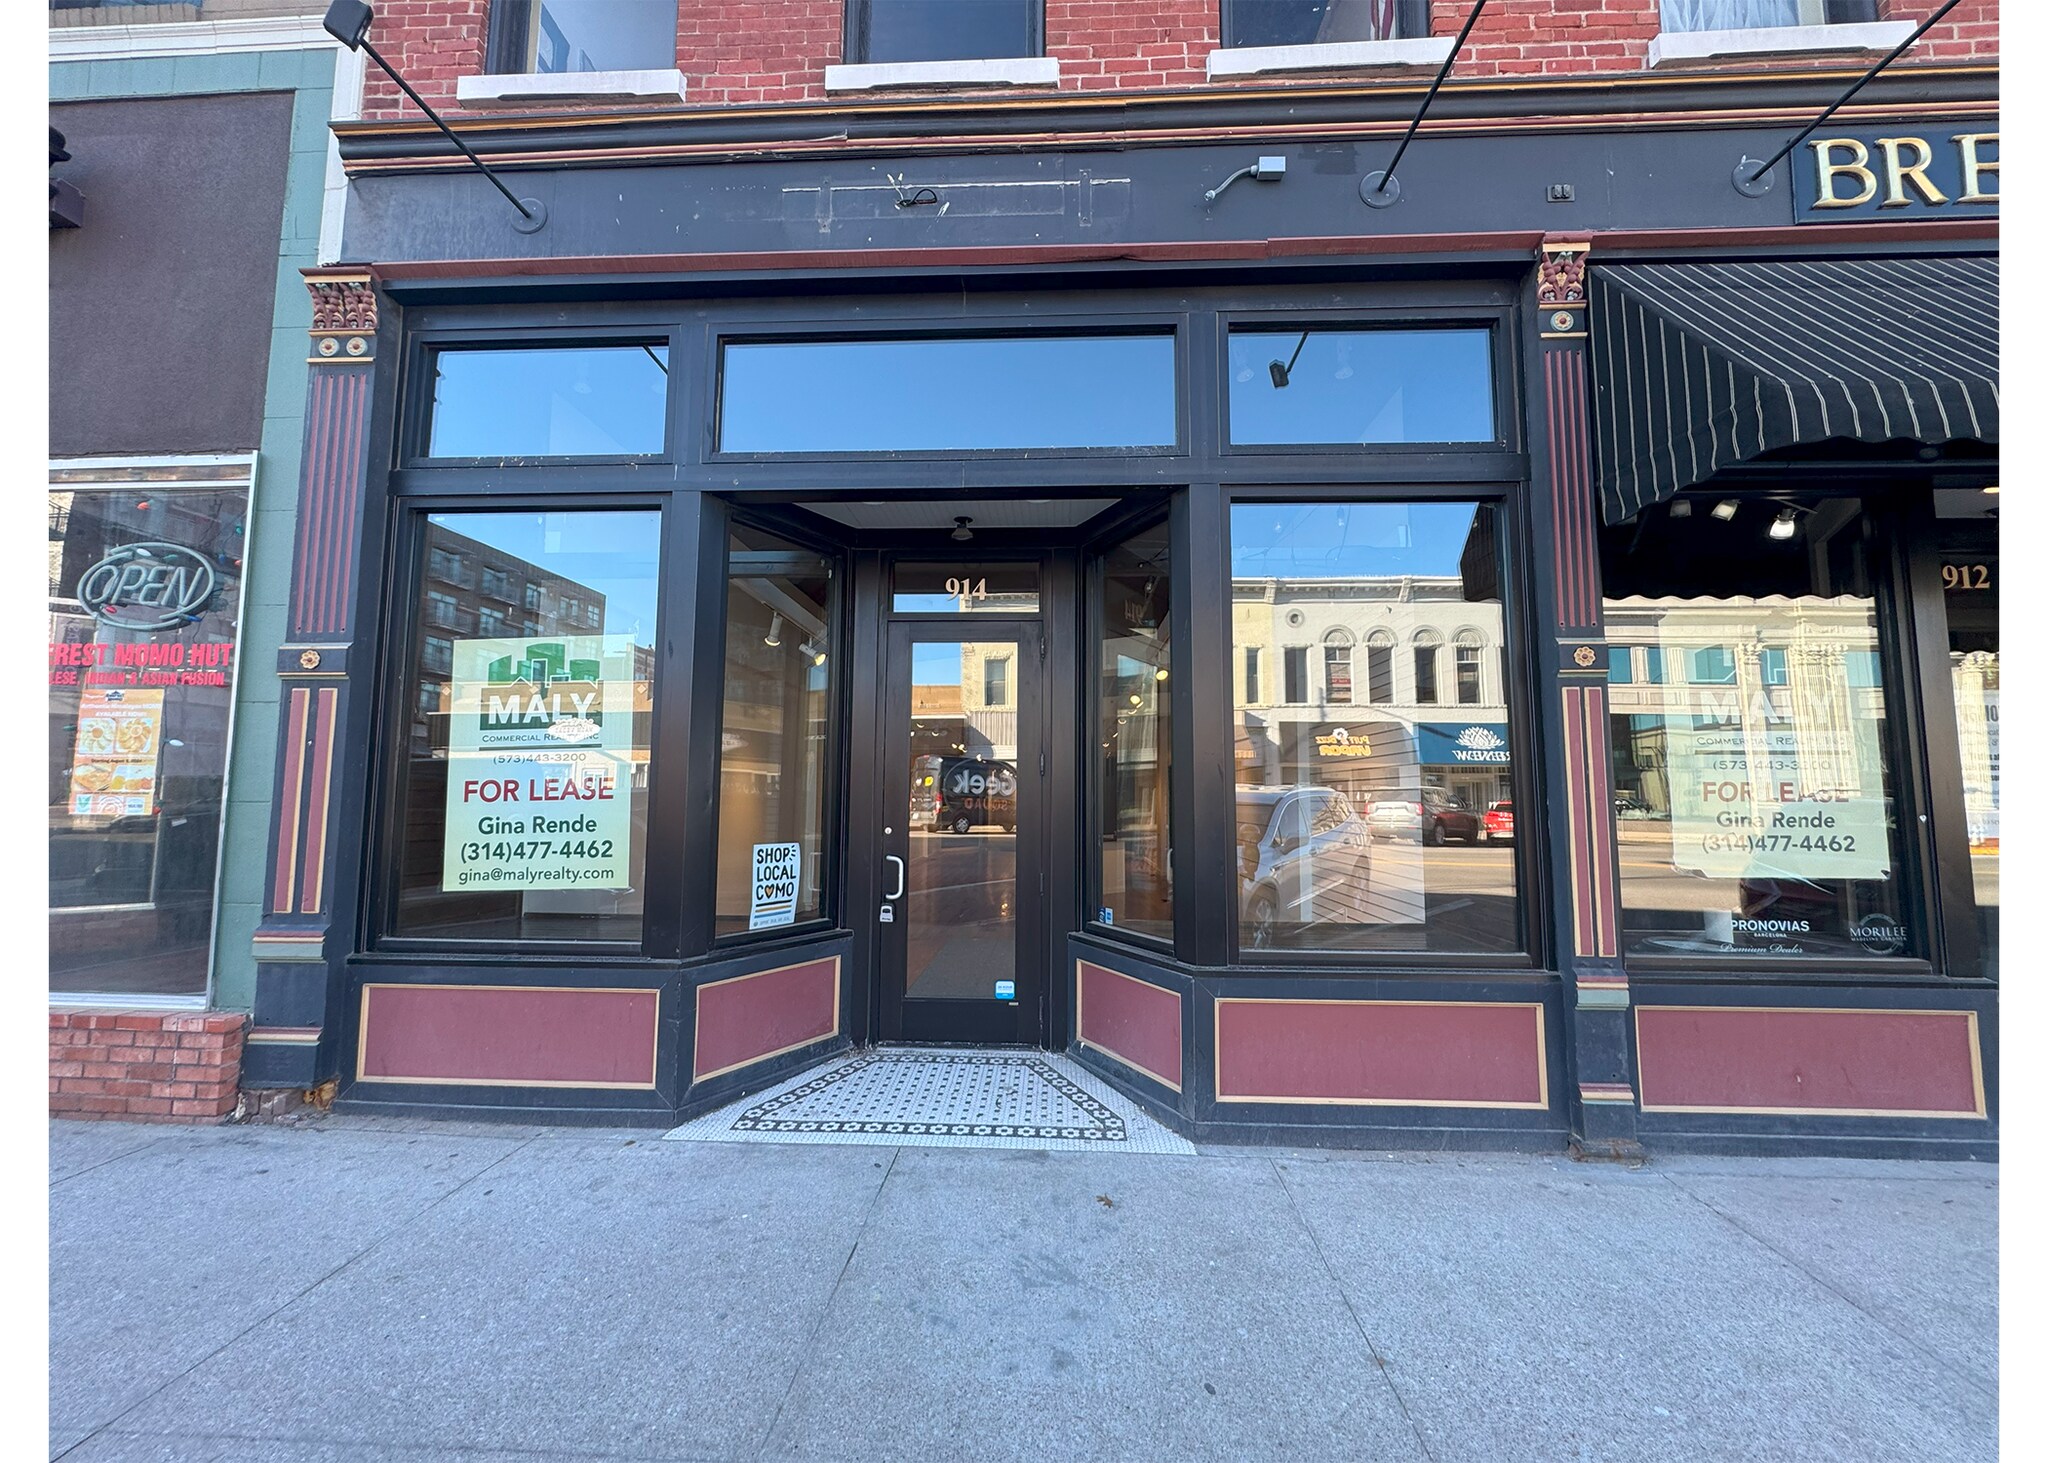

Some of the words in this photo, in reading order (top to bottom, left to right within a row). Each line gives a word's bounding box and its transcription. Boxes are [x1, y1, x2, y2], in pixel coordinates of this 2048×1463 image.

[85, 565, 204, 606] OPEN
[1942, 565, 1990, 589] 912
[945, 577, 987, 602] 914
[114, 643, 185, 667] MOMO
[190, 643, 233, 666] HUT
[140, 671, 178, 686] ASIAN
[181, 671, 225, 686] FUSION
[488, 692, 597, 725] MALY
[482, 734, 541, 743] COMMERCIAL
[493, 753, 587, 764] (573)443-3200
[463, 780, 519, 803] FOR
[529, 777, 614, 802] LEASE
[1702, 781, 1755, 803] FOR
[478, 816, 525, 835] Gina
[532, 814, 597, 834] Rende
[1716, 811, 1765, 828] Gina
[1772, 811, 1836, 828] Rende
[461, 839, 613, 864] (314)477-4462
[1702, 835, 1856, 854] (314)477-4462
[756, 847, 791, 864] SHOP
[458, 867, 614, 885] gina@malyrealty.com
[757, 864, 797, 882] LOCAL
[1731, 920, 1810, 932] PRONOVIAS
[1850, 927, 1908, 937] MORILEE
[1720, 943, 1767, 953] Premium
[1769, 943, 1803, 953] Dealer
